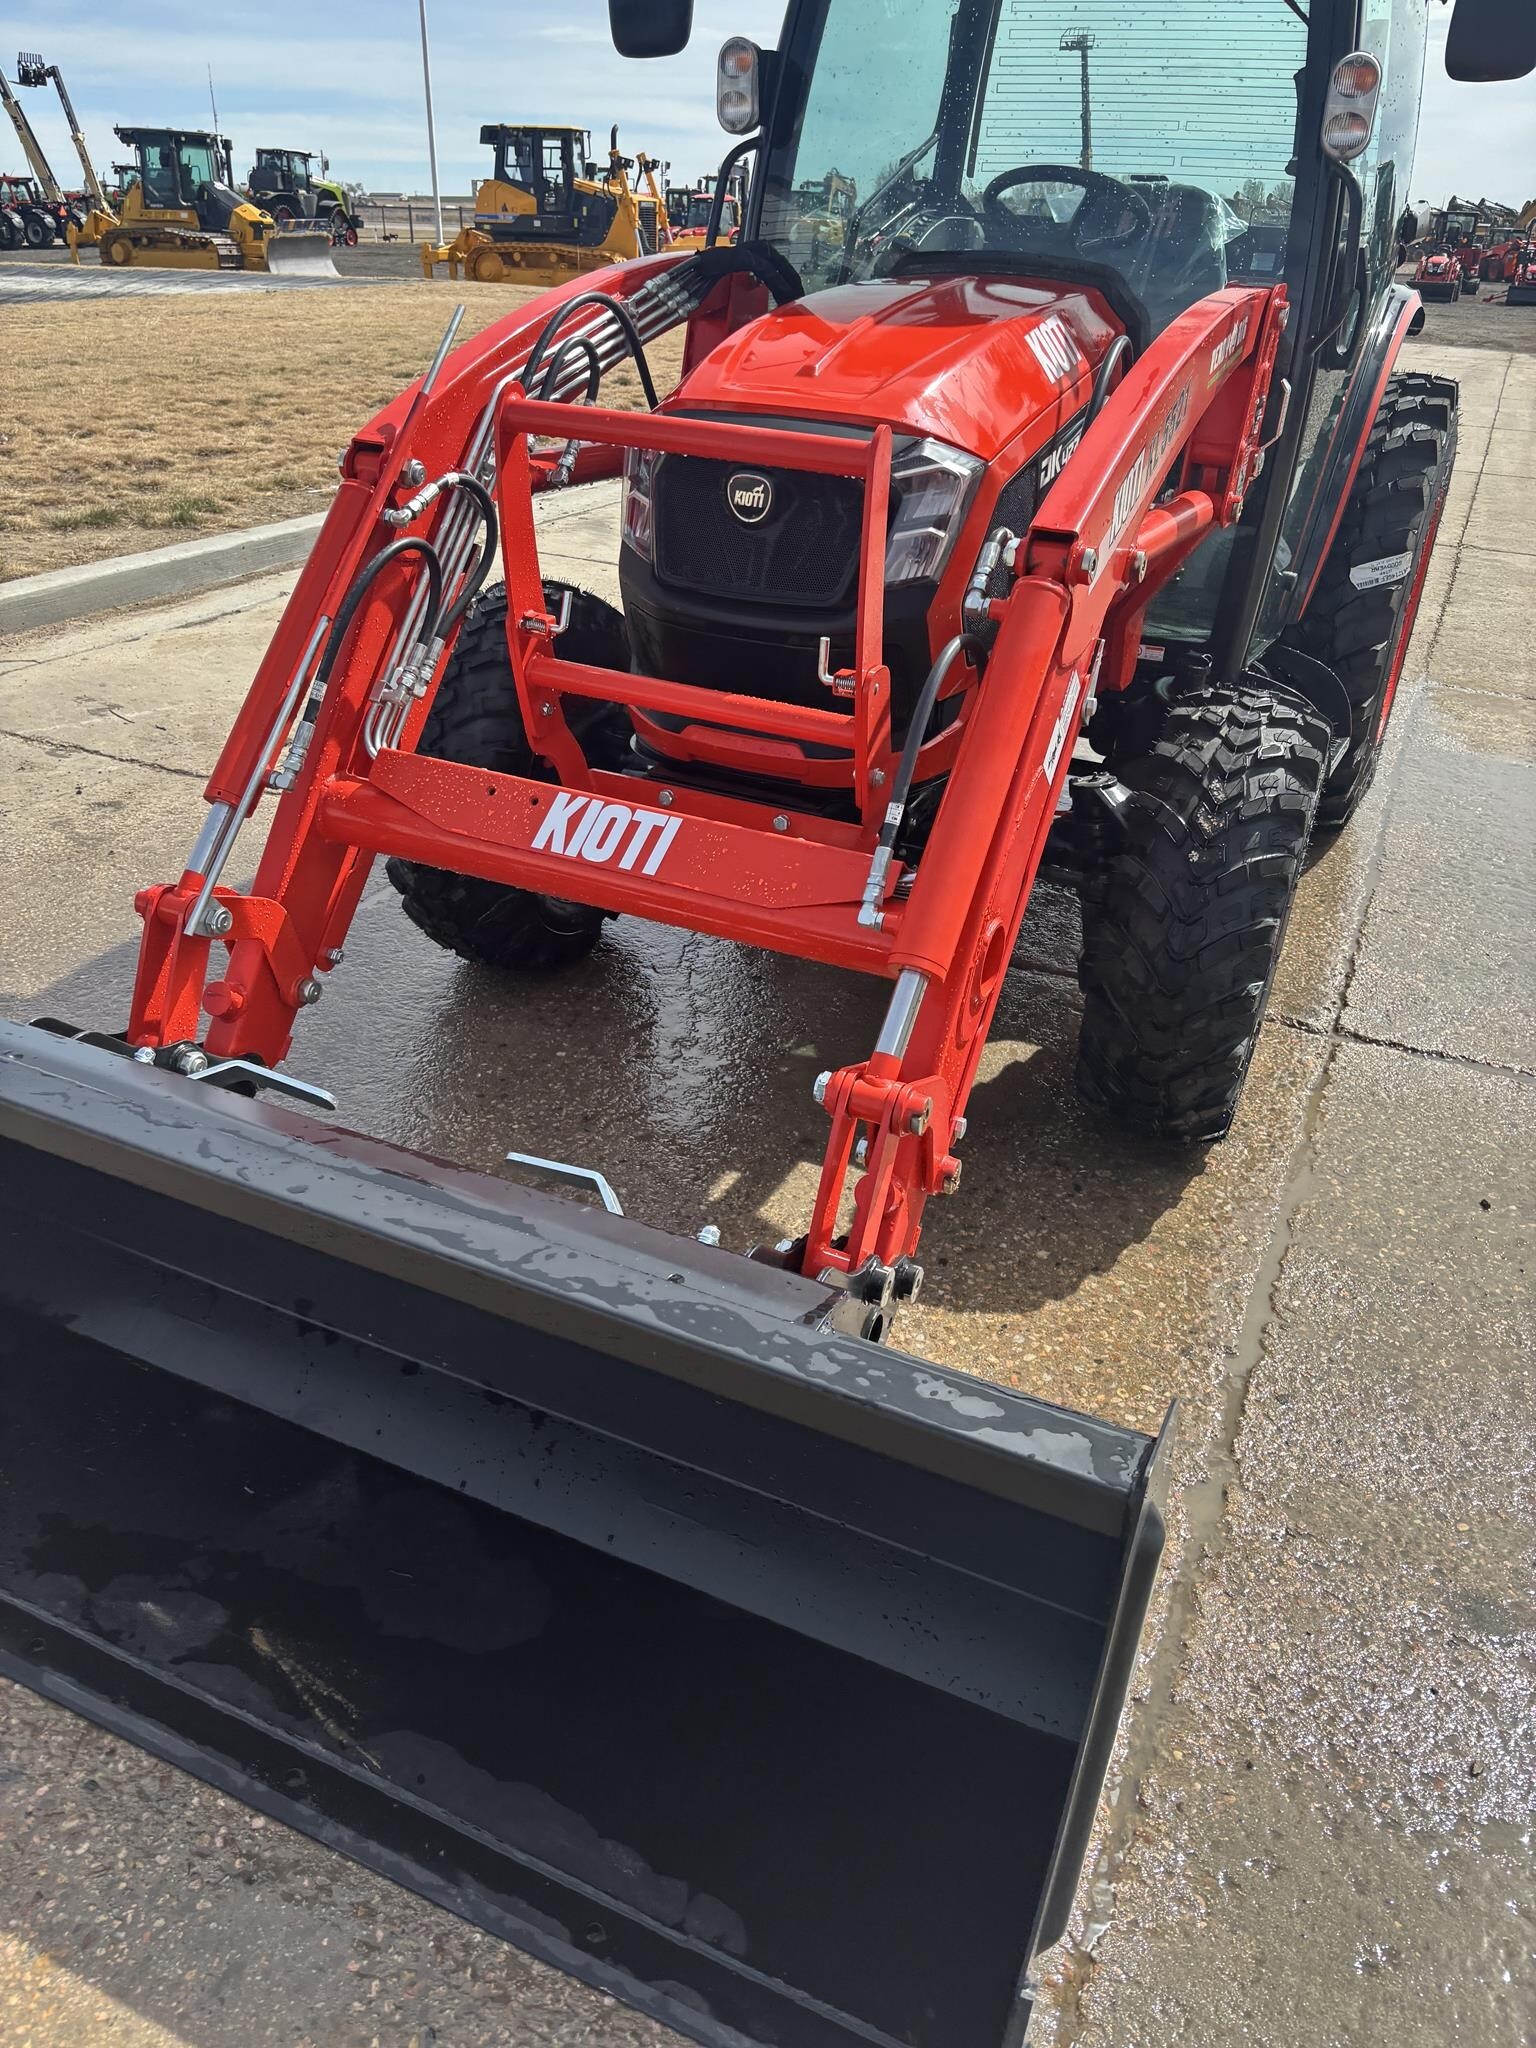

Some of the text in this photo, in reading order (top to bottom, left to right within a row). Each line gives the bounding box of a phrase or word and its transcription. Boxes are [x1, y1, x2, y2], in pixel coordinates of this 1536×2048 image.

[1024, 314, 1082, 385] KIOTI
[733, 485, 765, 508] KIOTI
[1109, 447, 1146, 548] KIOTI
[530, 791, 683, 876] KIOTI
